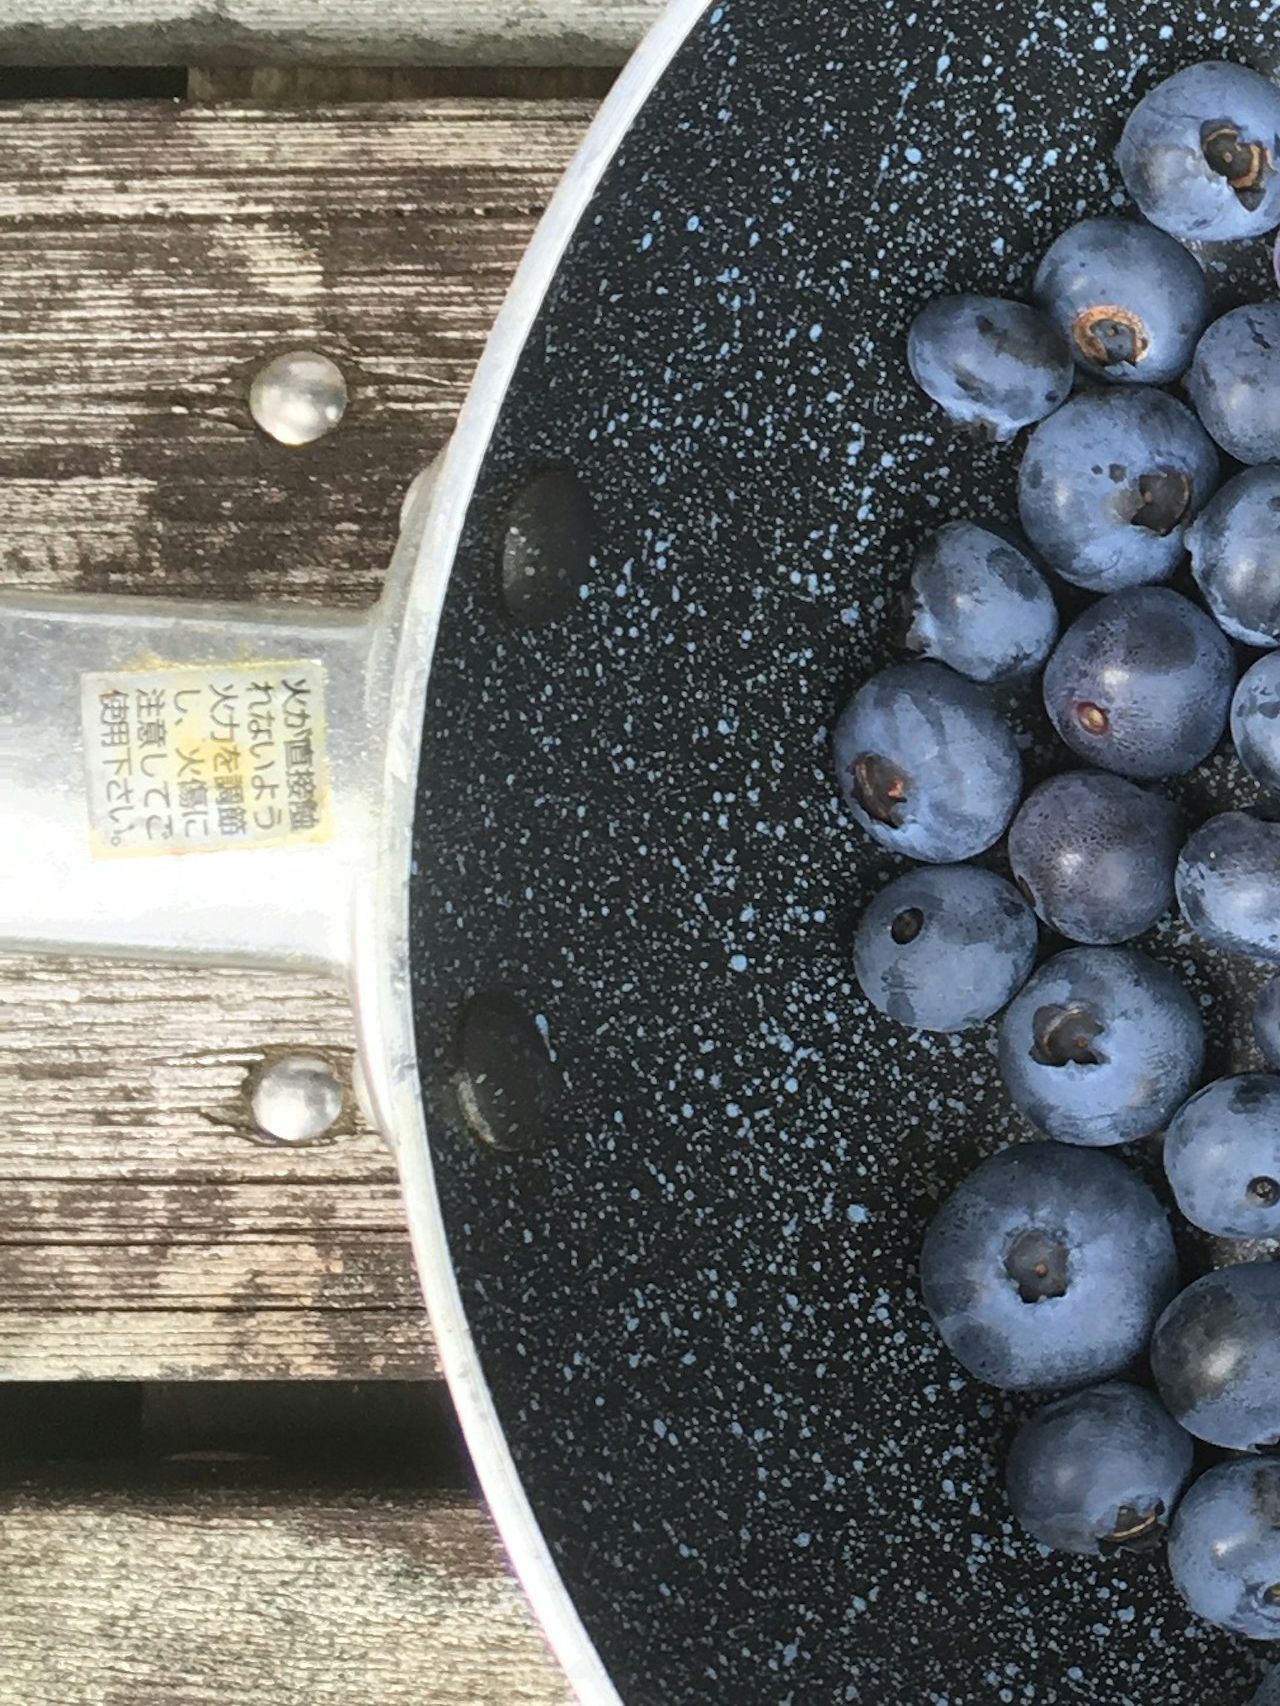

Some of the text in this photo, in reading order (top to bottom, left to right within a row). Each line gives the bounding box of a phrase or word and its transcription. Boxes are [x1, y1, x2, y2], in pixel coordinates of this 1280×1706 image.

[99, 689, 135, 846] 使用下さい。
[135, 687, 173, 841] 注意してご
[173, 688, 209, 838] し、火傷に
[209, 683, 247, 836] 火力を調節
[245, 681, 282, 830] れないよう
[281, 677, 320, 831] 火が直接触
